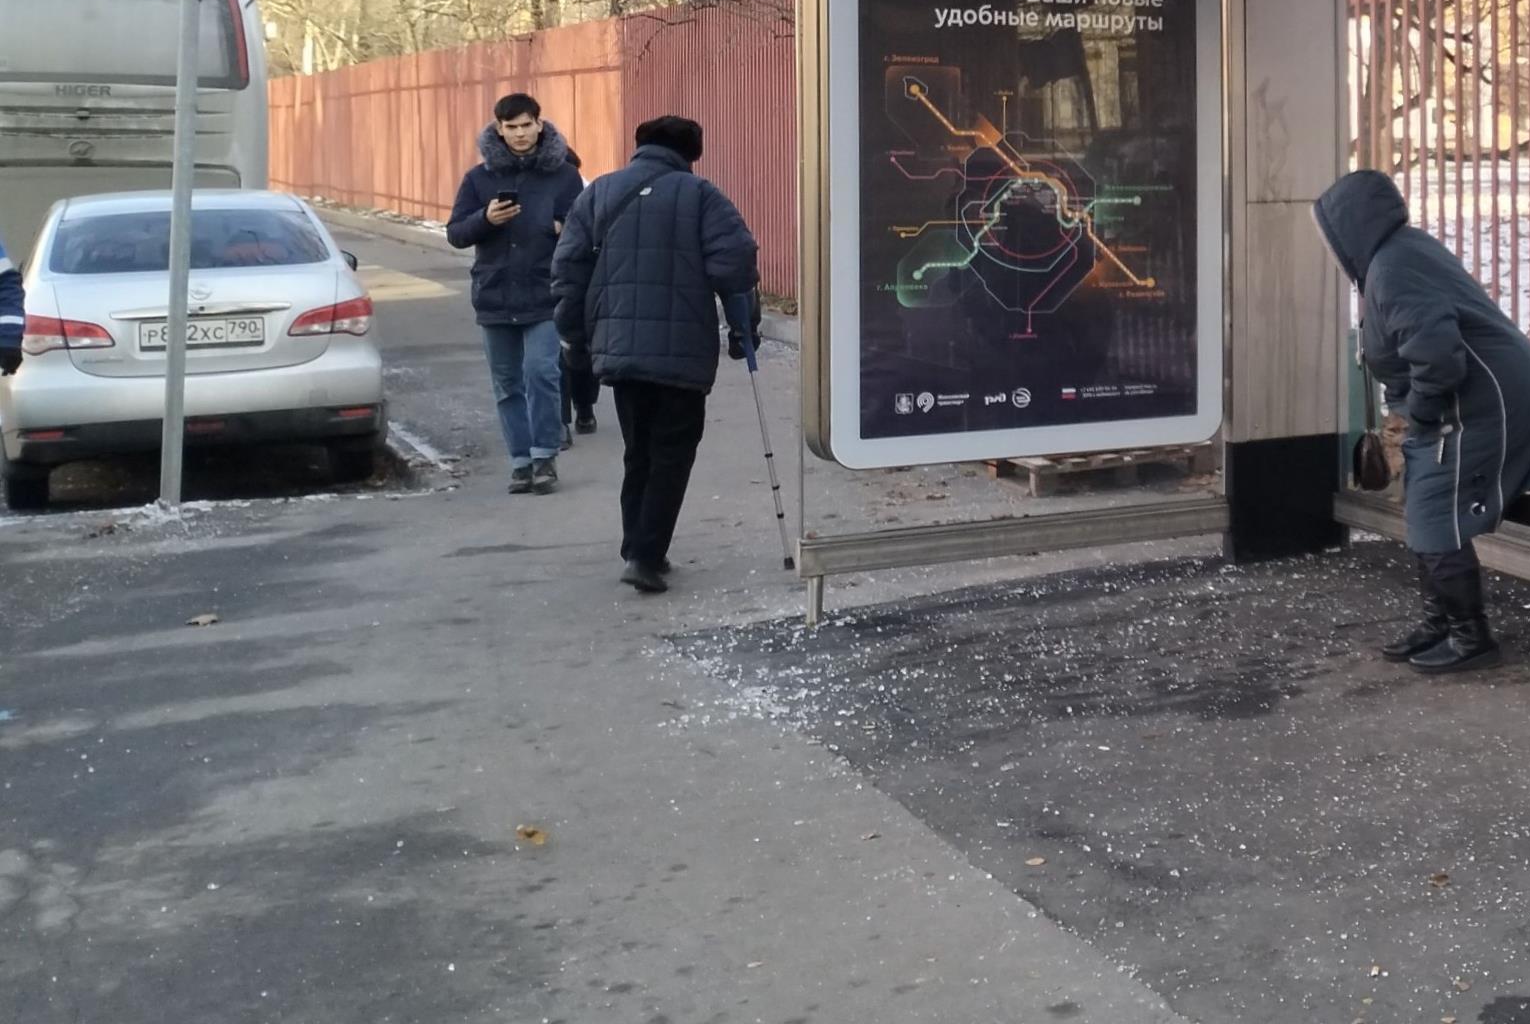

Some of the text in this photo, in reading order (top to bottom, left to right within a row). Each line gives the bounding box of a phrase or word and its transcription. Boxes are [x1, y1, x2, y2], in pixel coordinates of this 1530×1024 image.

[934, 4, 1164, 34] удобные маршруты
[55, 84, 112, 97] HIGER
[228, 320, 258, 335] 790
